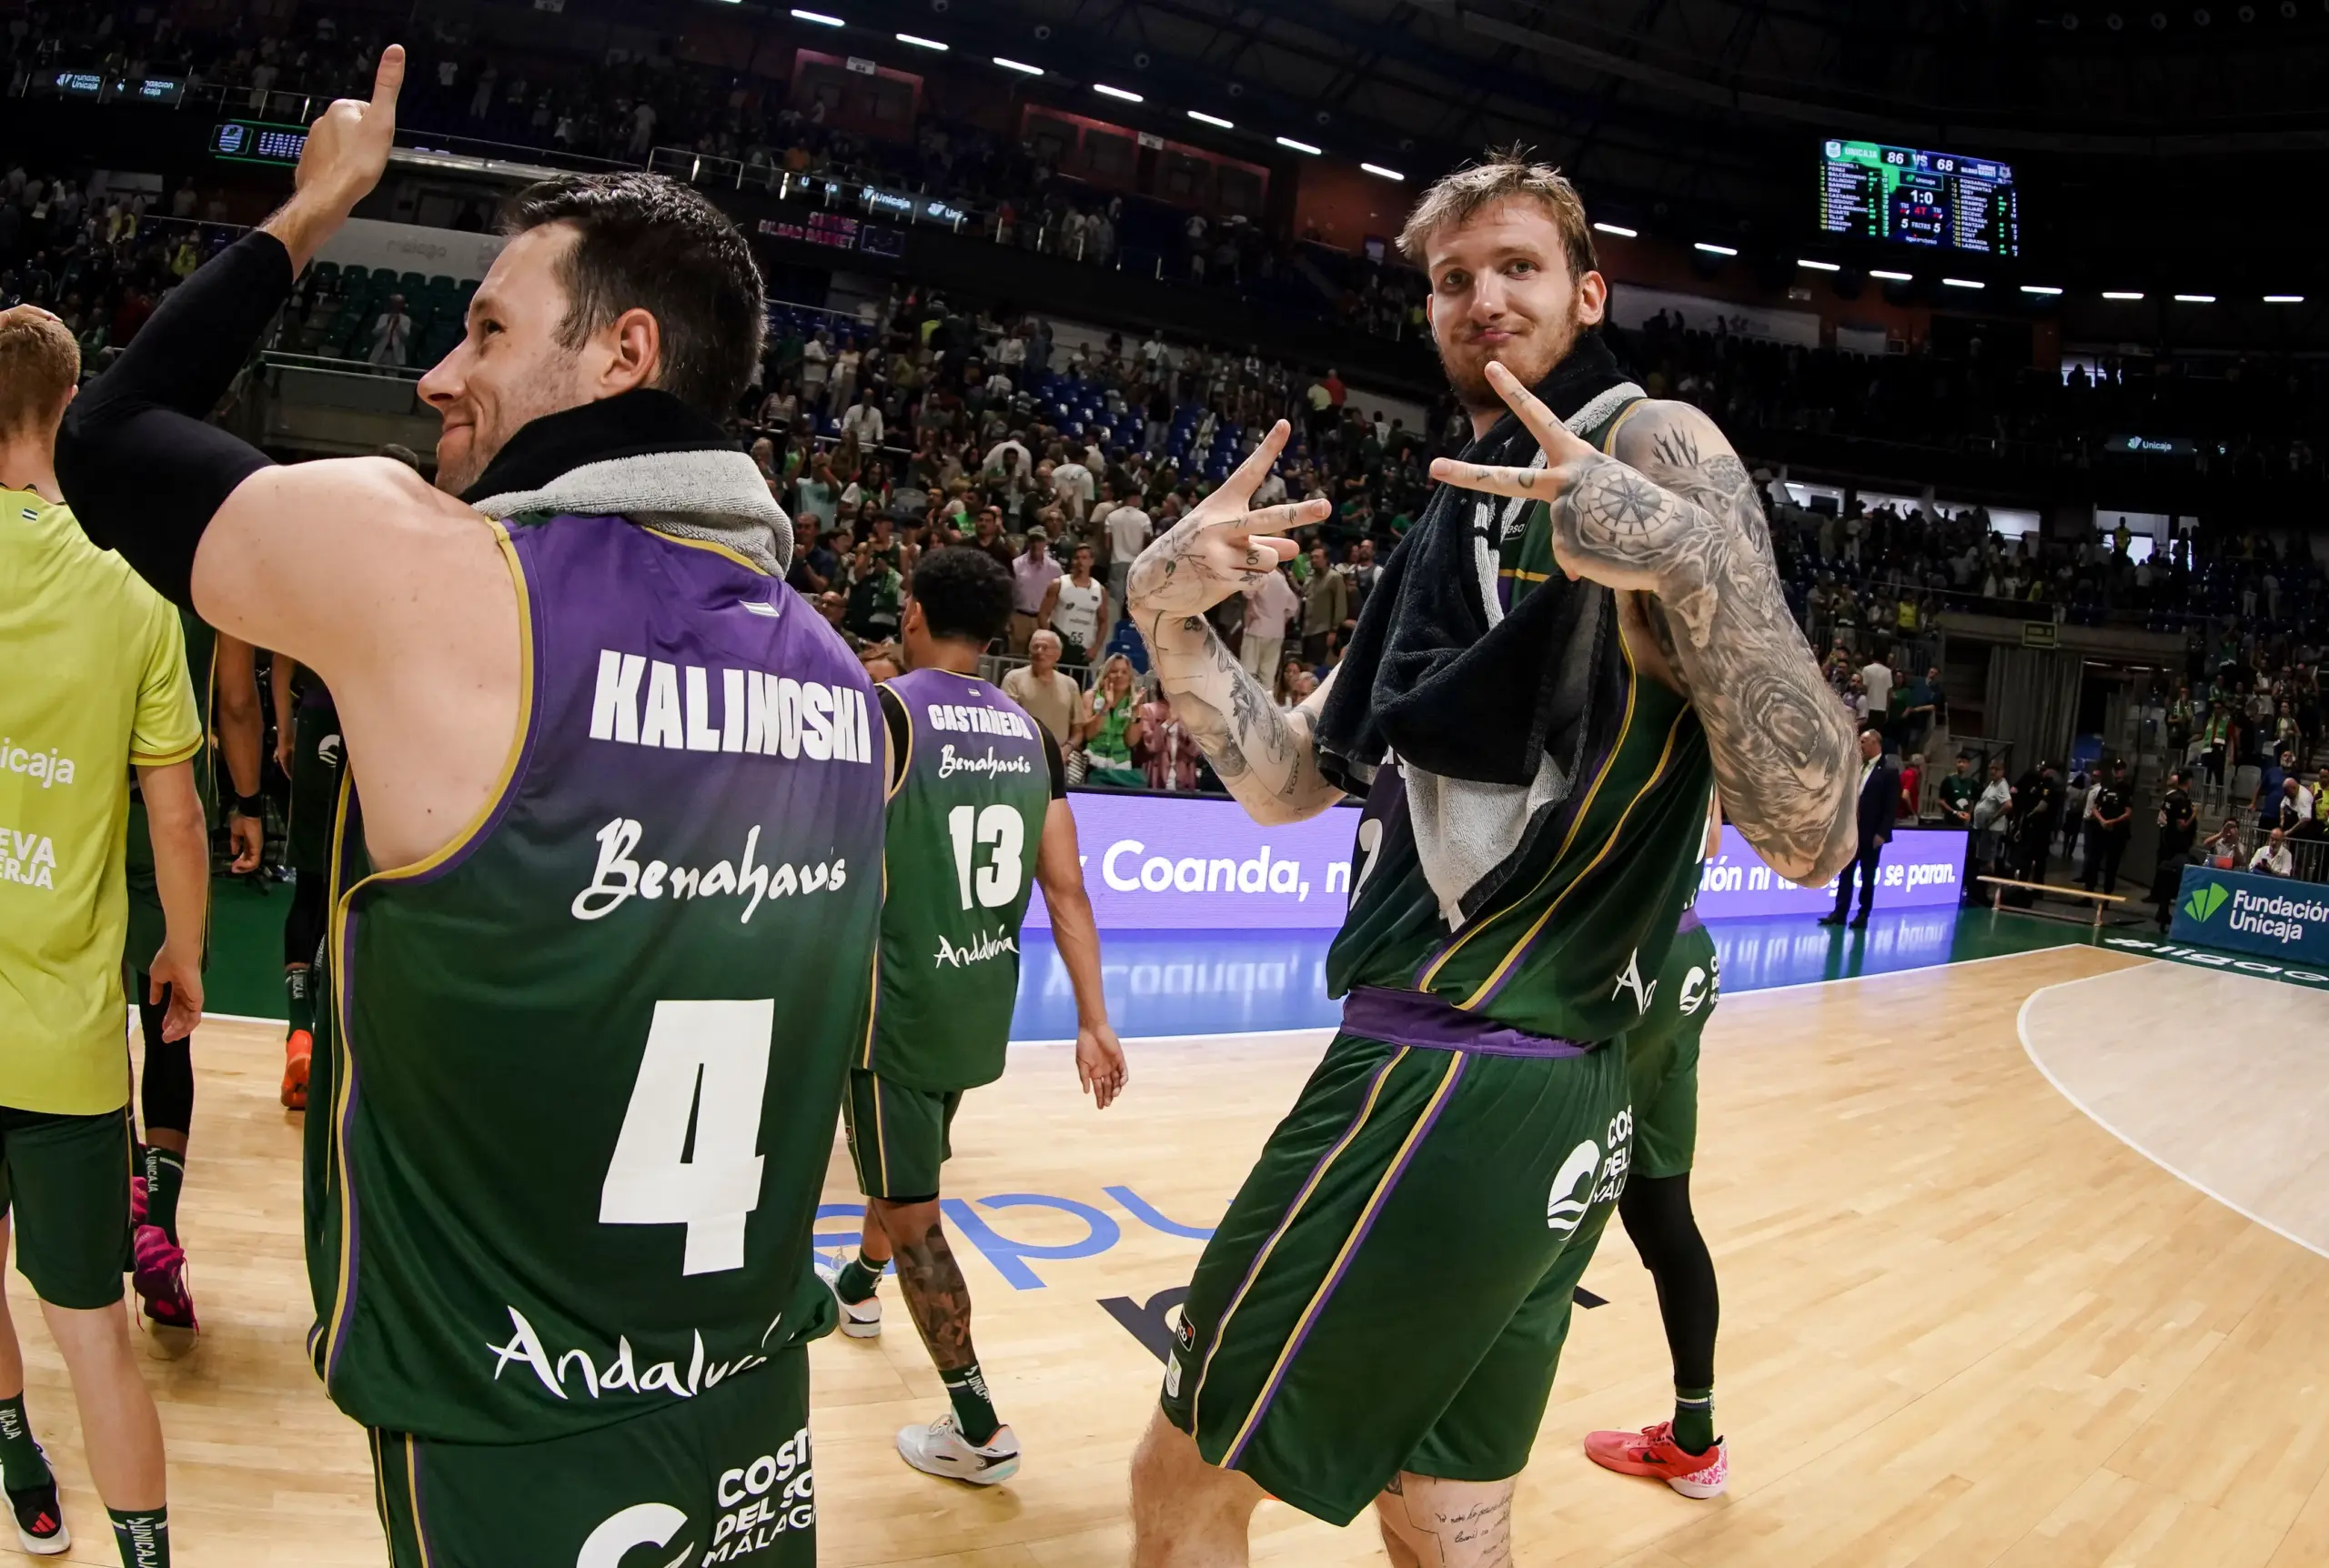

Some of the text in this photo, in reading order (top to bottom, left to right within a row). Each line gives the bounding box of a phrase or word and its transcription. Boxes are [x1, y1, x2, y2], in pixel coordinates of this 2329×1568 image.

[1887, 151, 1904, 165] 86
[1911, 153, 1928, 167] VS
[1936, 158, 1953, 171] 68
[874, 192, 911, 210] Unicaja
[1910, 189, 1933, 206] 1:0
[1901, 218, 1909, 229] 5
[1933, 223, 1941, 234] 5
[2142, 440, 2173, 452] Unicaja
[589, 648, 872, 764] KALINOSKI
[928, 704, 1033, 740] CASTAÑEDA
[571, 817, 847, 924] Benahavs
[948, 804, 1024, 910] 13
[1102, 839, 1309, 902] Coanda,
[1748, 864, 1770, 891] ni
[1883, 863, 1904, 886] se
[1906, 863, 1956, 892] paran.
[2230, 910, 2304, 943] Unicaja
[599, 999, 774, 1276] 4
[146, 1156, 159, 1193] UNICAJA
[1599, 1147, 1628, 1183] DEL
[486, 1304, 796, 1400] Andalu
[717, 1427, 812, 1508] COST
[701, 1503, 817, 1568] MÁLAG
[712, 1496, 776, 1546] DEL
